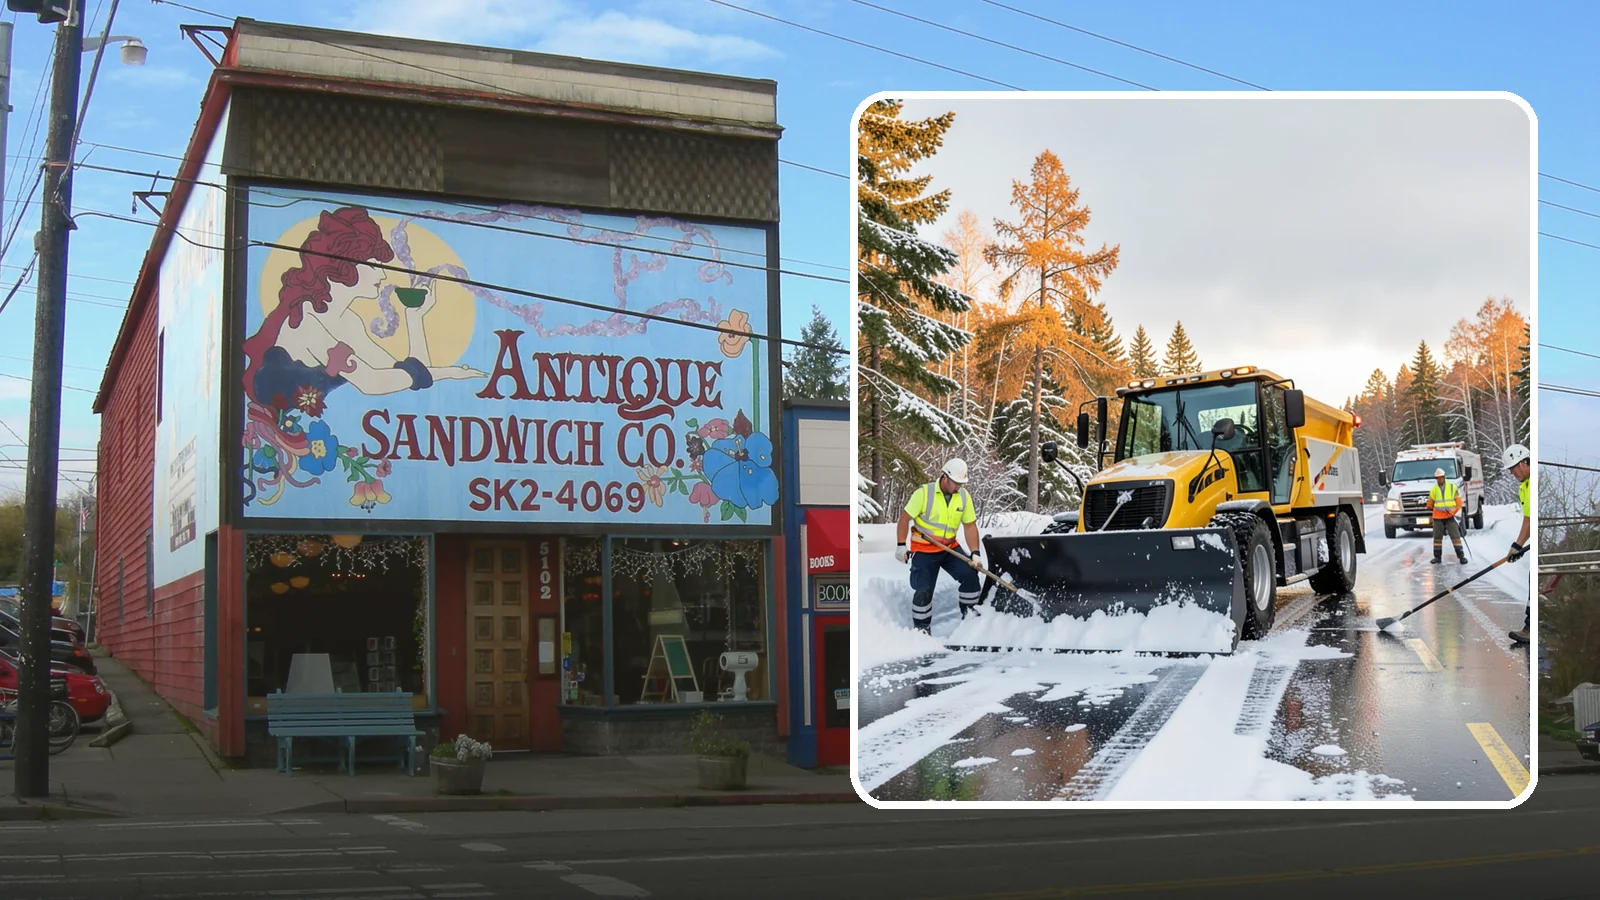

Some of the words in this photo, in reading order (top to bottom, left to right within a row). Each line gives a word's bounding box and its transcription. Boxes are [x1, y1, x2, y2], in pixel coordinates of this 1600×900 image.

[475, 329, 724, 420] ANTIQUE
[361, 408, 604, 467] SANDWICH
[617, 421, 685, 468] CO.
[468, 477, 646, 513] SK2-4069
[540, 541, 551, 600] 5102
[809, 554, 835, 569] BOOKS
